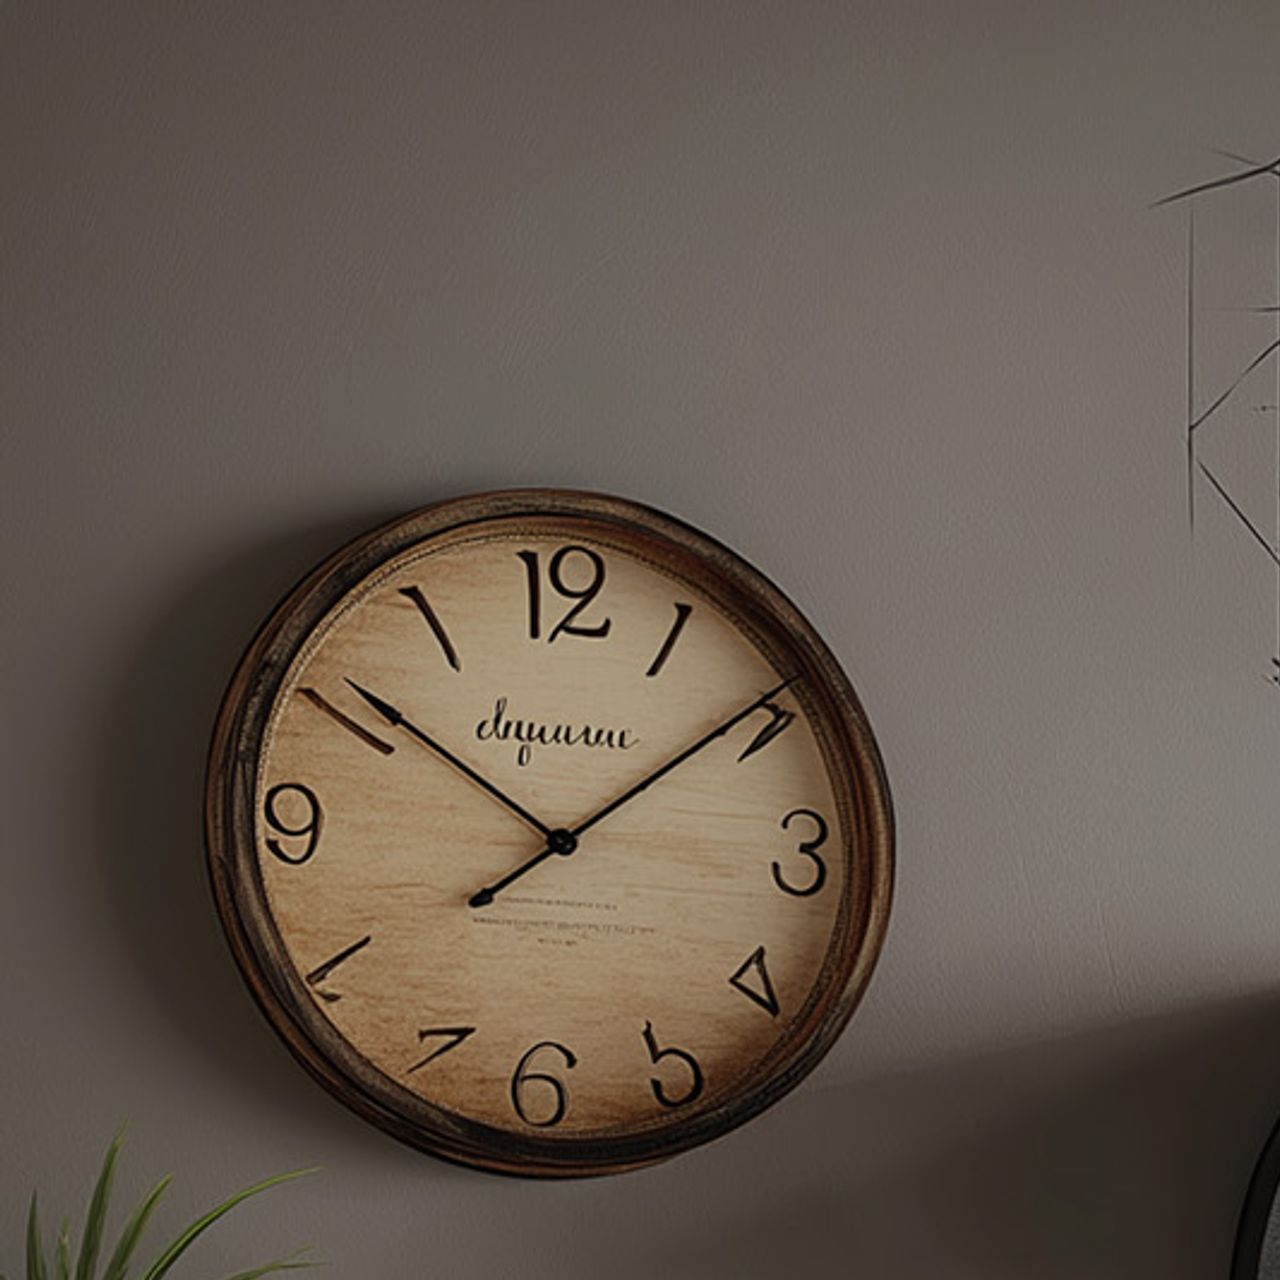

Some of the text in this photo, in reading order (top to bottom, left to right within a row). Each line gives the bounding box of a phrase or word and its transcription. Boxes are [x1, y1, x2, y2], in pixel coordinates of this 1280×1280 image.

[516, 545, 612, 644] 12
[263, 782, 323, 866] 9
[771, 808, 828, 897] 3
[510, 1041, 577, 1128] 6
